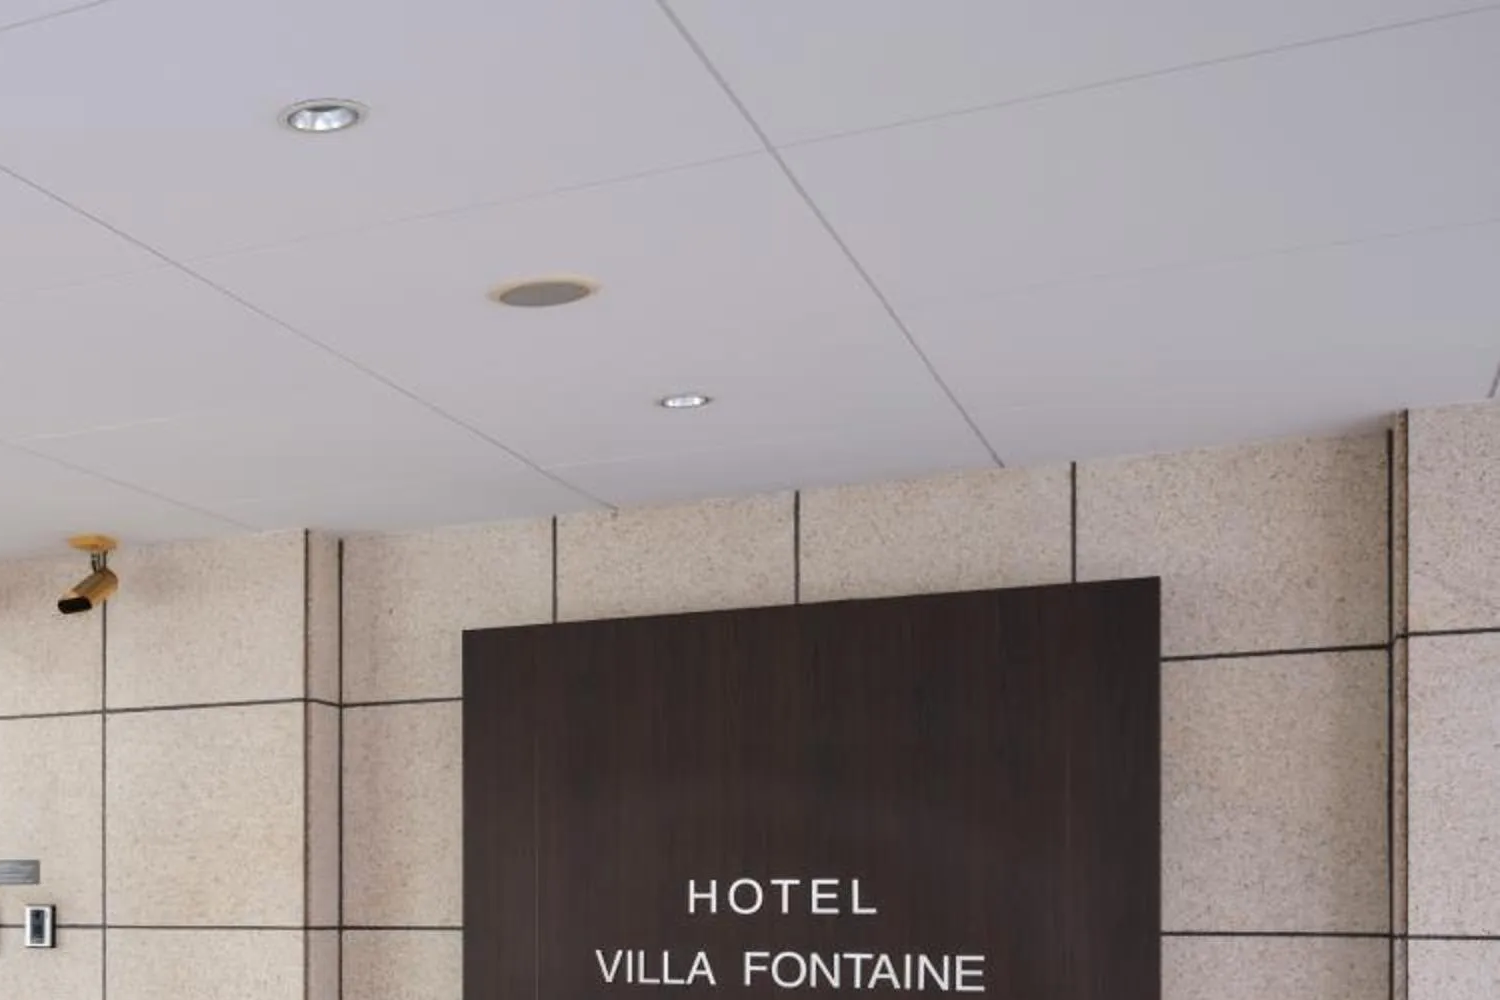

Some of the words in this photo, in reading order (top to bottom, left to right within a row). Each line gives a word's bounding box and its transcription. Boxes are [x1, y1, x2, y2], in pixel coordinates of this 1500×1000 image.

[688, 877, 877, 915] HOTEL
[595, 949, 717, 986] VILLA
[744, 951, 985, 992] FONTAINE
